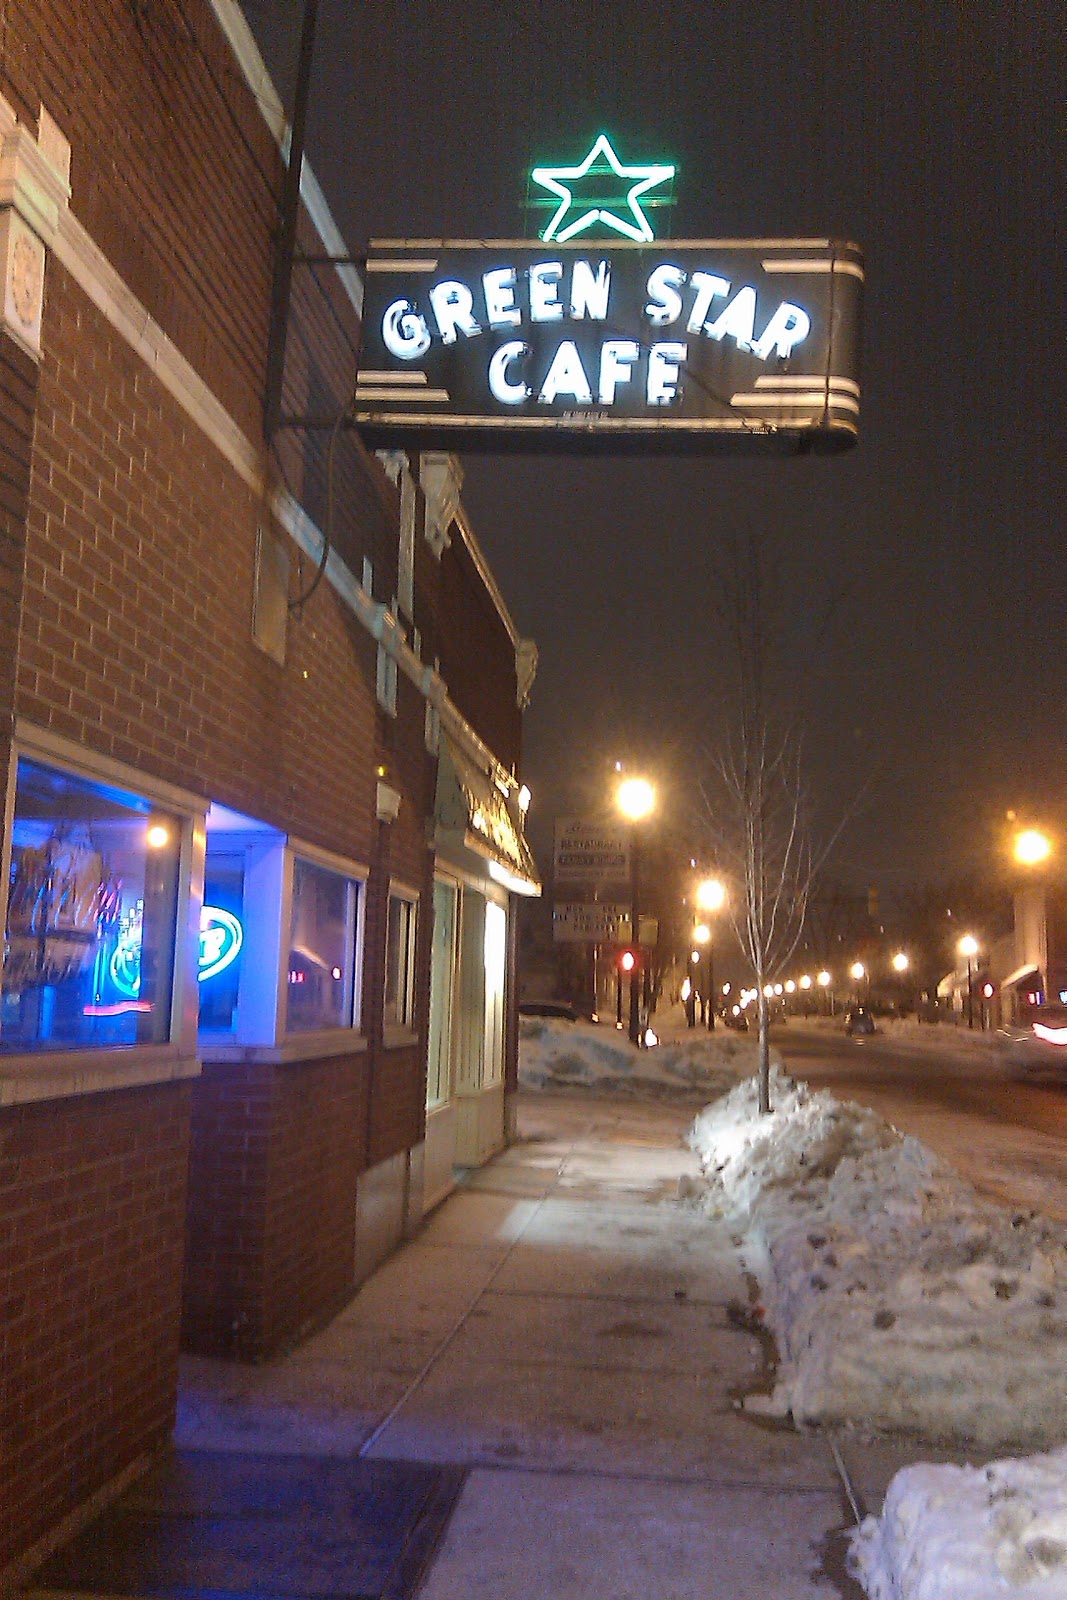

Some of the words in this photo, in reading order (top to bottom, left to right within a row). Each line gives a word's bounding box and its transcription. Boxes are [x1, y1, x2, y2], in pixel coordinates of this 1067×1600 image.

[381, 259, 611, 361] GREEN
[644, 263, 811, 361] STAR
[488, 339, 688, 406] CAFE
